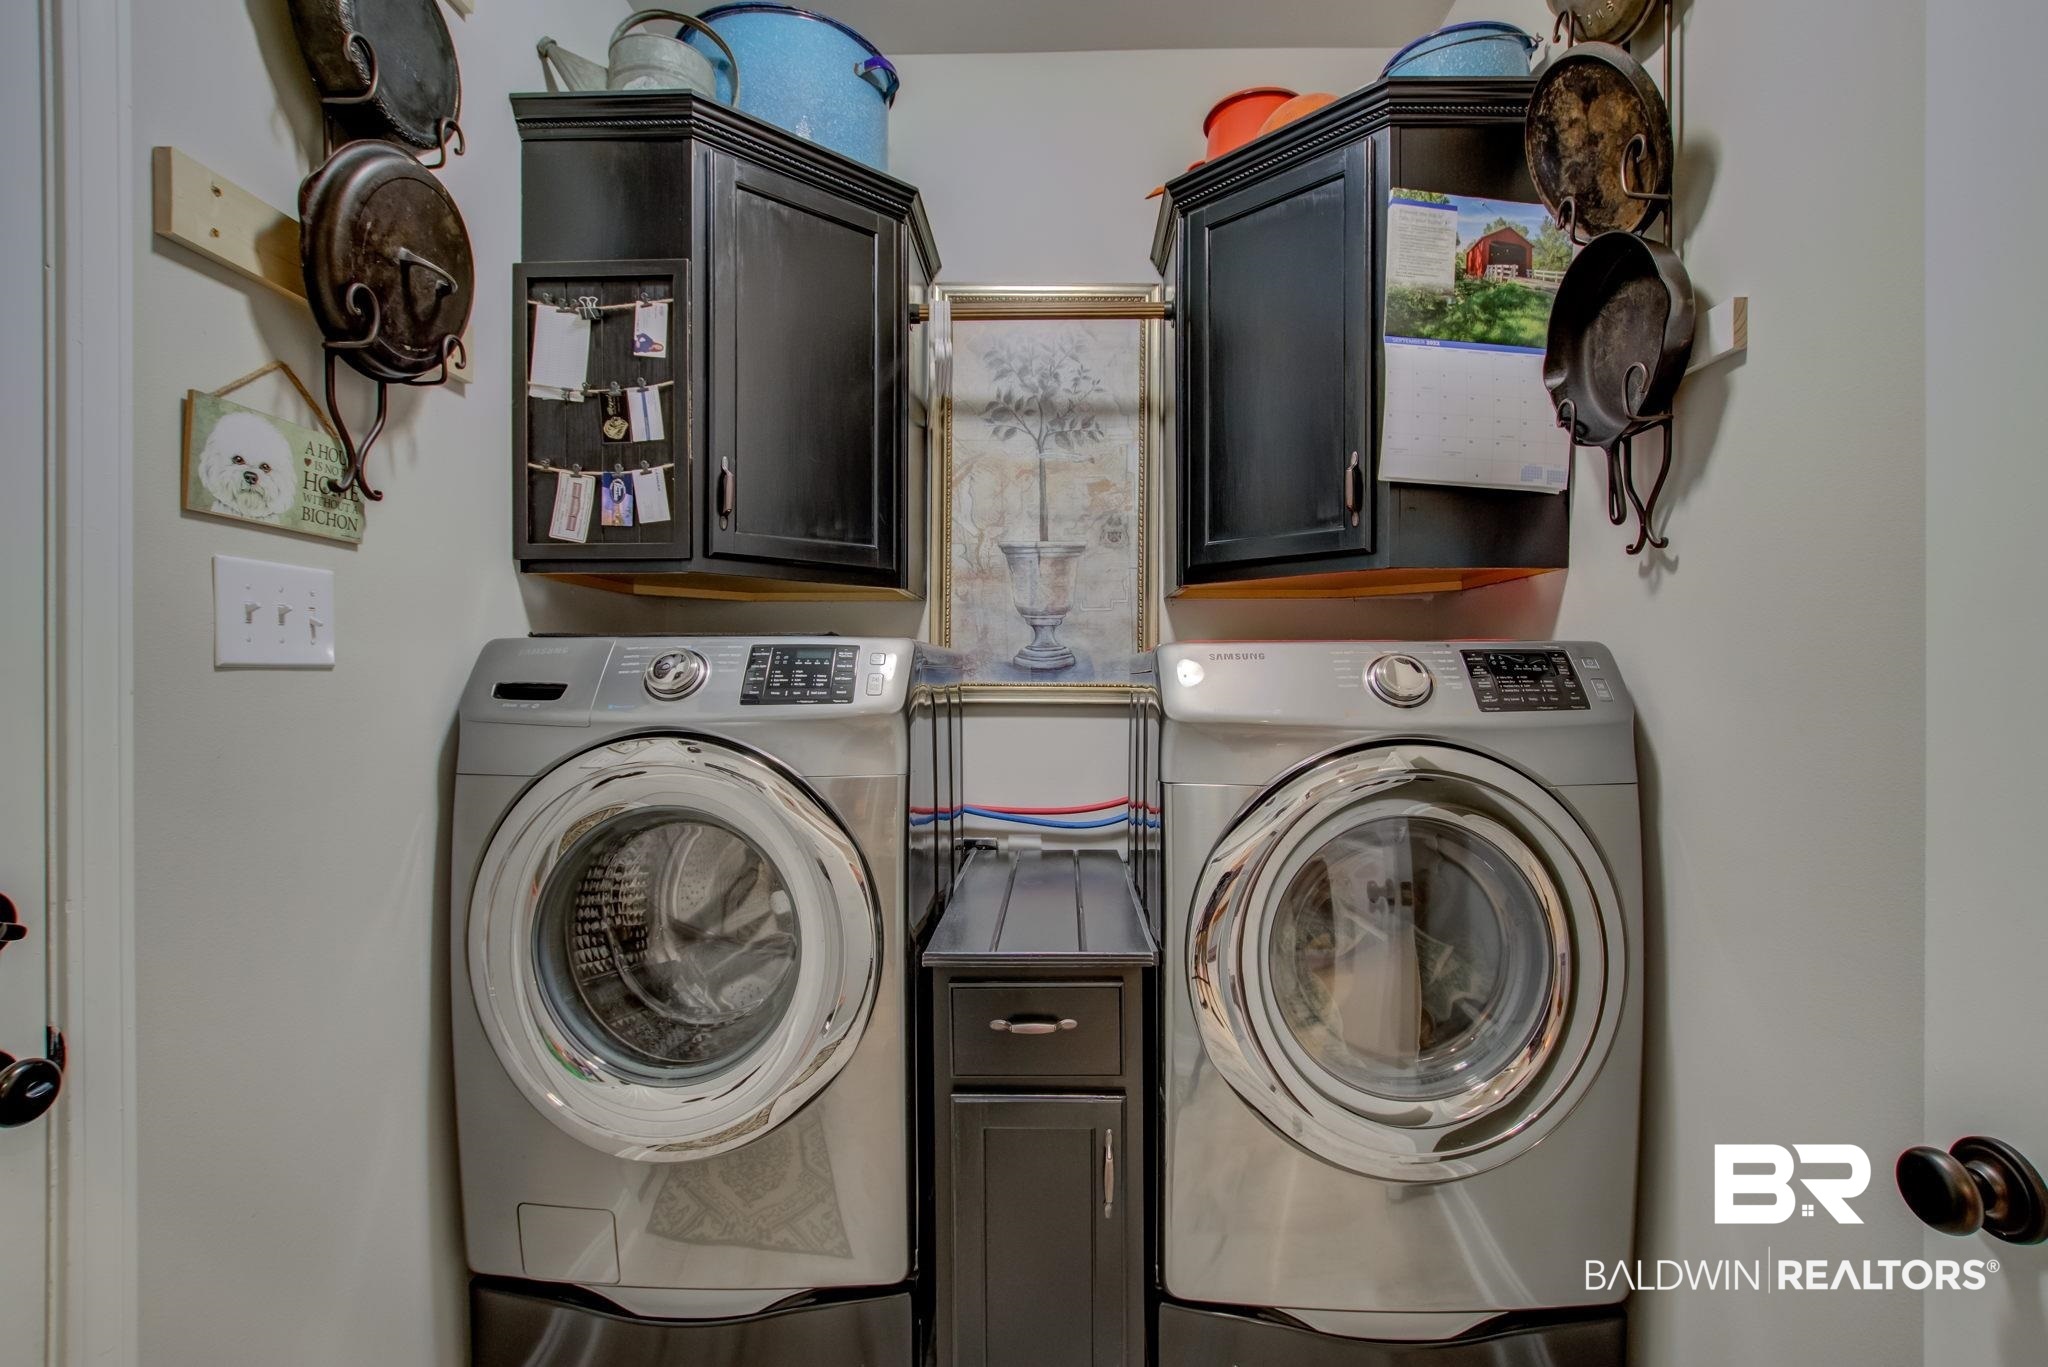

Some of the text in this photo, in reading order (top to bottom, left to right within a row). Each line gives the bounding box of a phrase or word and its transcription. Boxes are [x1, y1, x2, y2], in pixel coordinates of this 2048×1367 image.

[305, 441, 348, 466] A HOU
[314, 460, 323, 471] IS
[303, 471, 360, 502] HOE
[301, 506, 359, 532] BICHON
[1208, 652, 1266, 661] SAMSUNG
